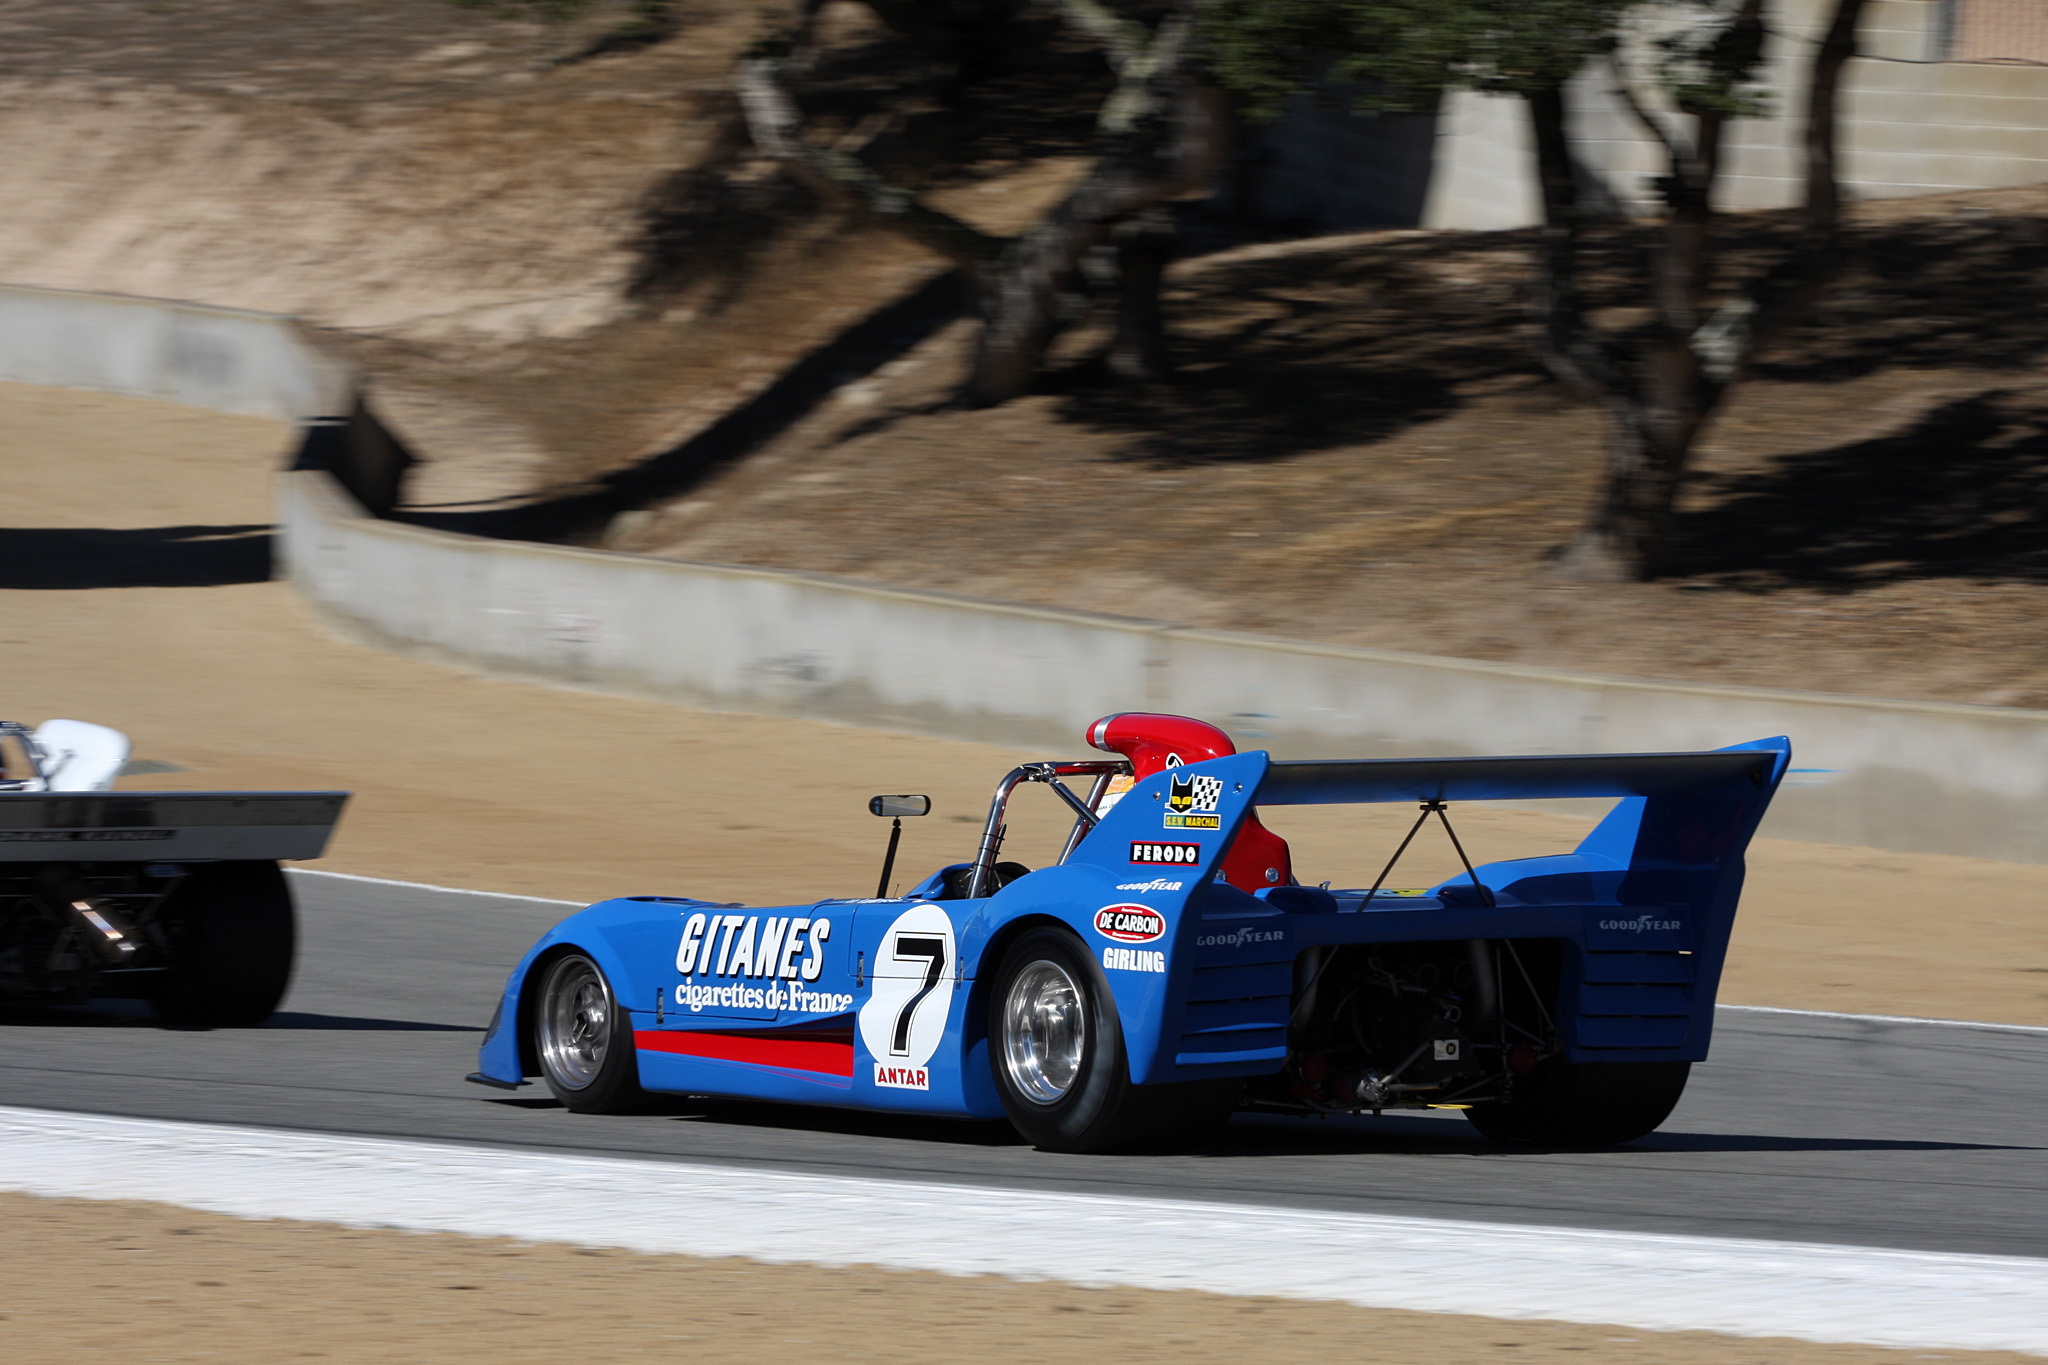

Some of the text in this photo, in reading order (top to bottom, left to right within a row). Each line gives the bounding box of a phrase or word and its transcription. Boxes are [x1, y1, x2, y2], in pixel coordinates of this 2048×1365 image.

[1185, 816, 1219, 828] MARCHAL
[1133, 844, 1196, 863] FERODO
[1116, 878, 1183, 894] GOODYEAR
[1099, 912, 1159, 934] DE CARBON
[1601, 915, 1681, 934] GOODYEAR
[675, 913, 831, 981] GITANES
[1197, 927, 1284, 948] GOODYEAR
[1103, 947, 1165, 973] GIRLING
[675, 976, 853, 1013] cigarettes de France
[889, 931, 948, 1058] 7
[878, 1067, 926, 1087] ANTAR
